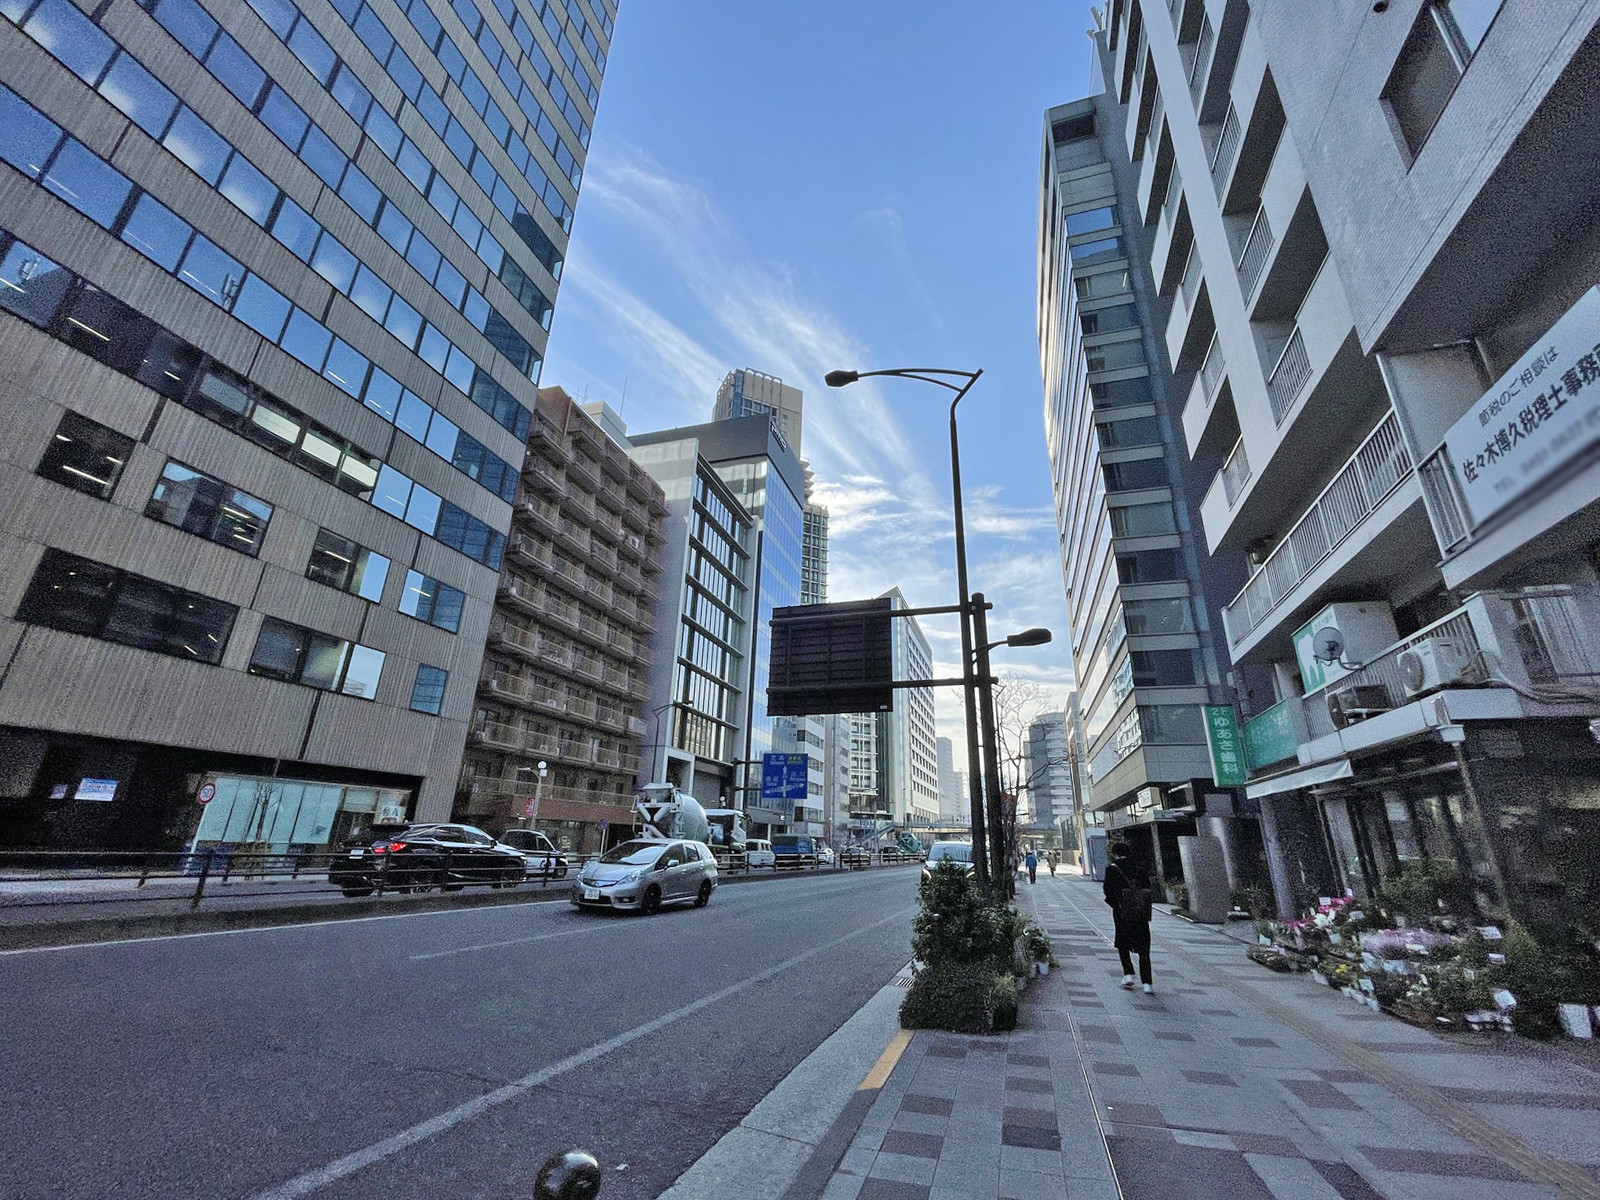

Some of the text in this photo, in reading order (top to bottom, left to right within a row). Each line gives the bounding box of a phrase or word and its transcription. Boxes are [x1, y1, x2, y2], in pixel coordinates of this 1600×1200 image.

[1478, 346, 1559, 427] 節税のご相談は
[1214, 716, 1239, 774] ゆあさ歯科
